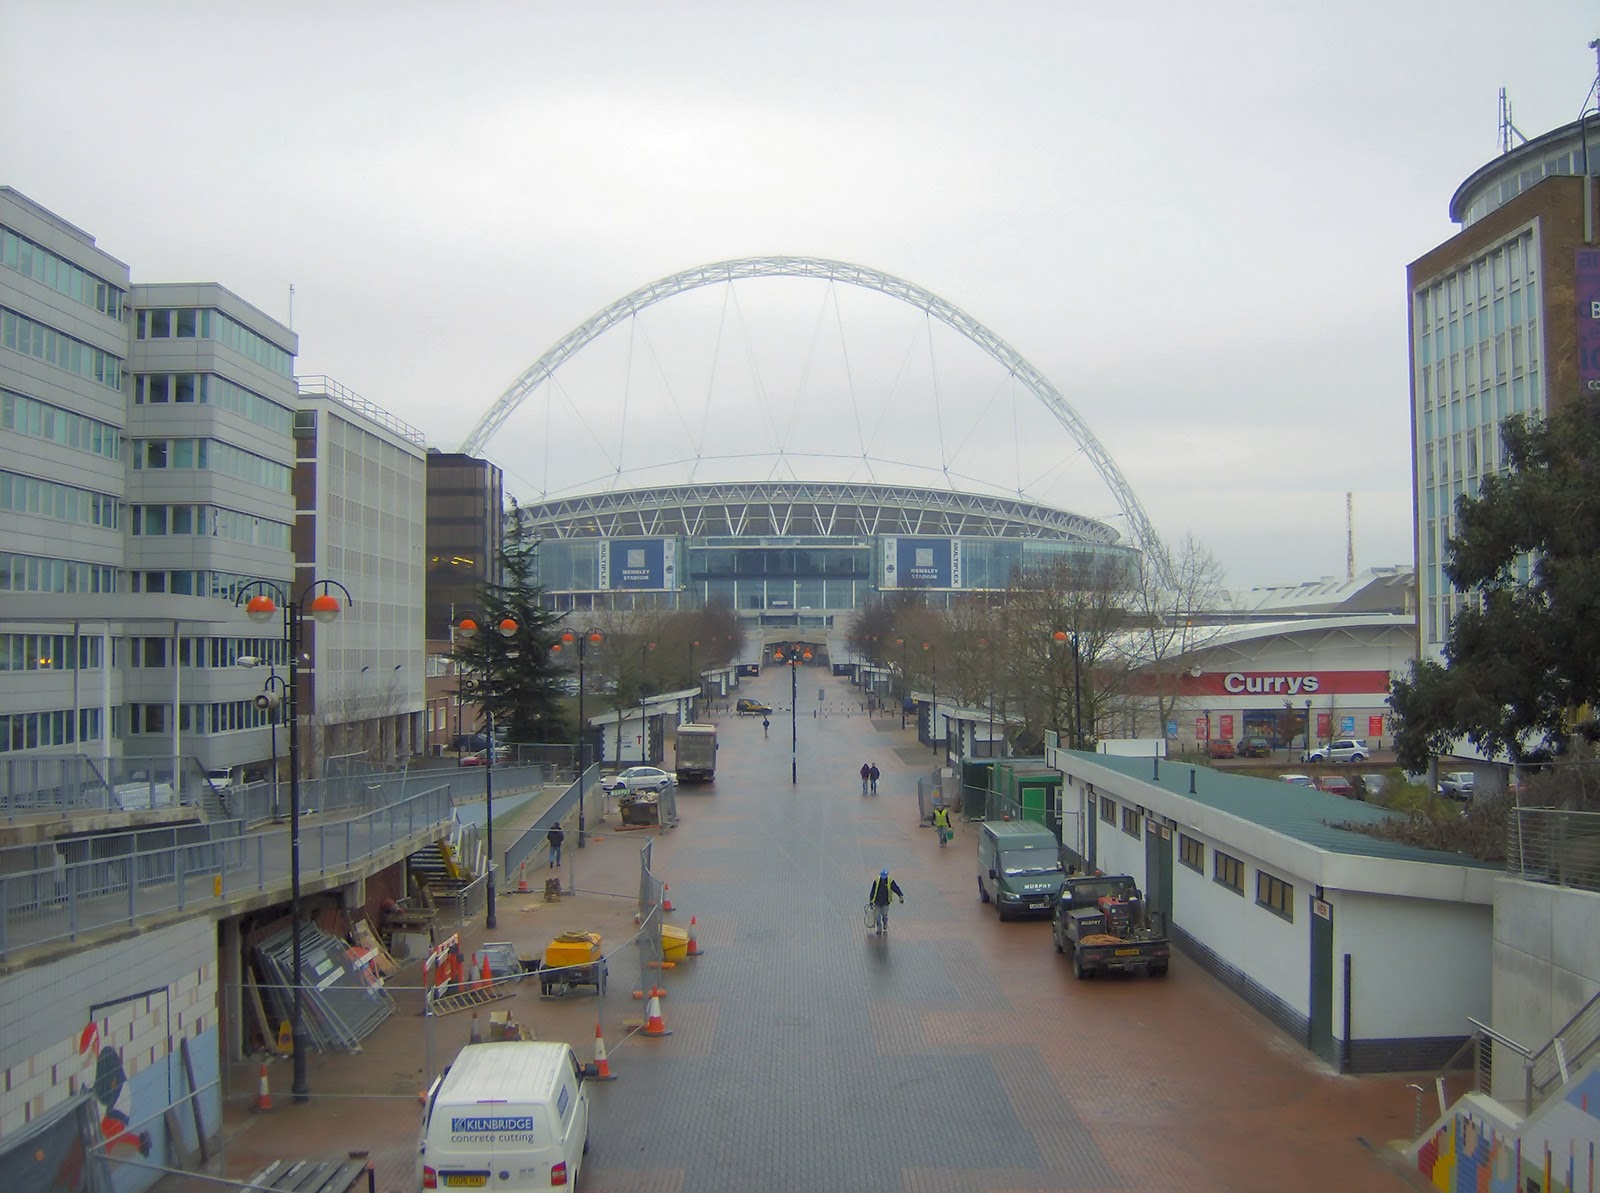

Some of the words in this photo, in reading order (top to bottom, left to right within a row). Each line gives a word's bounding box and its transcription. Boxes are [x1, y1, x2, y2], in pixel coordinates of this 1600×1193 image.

[1224, 673, 1319, 695] Currys
[467, 1118, 532, 1131] KILNBRIDGE
[451, 1134, 496, 1143] concrete
[498, 1133, 534, 1145] cutting
